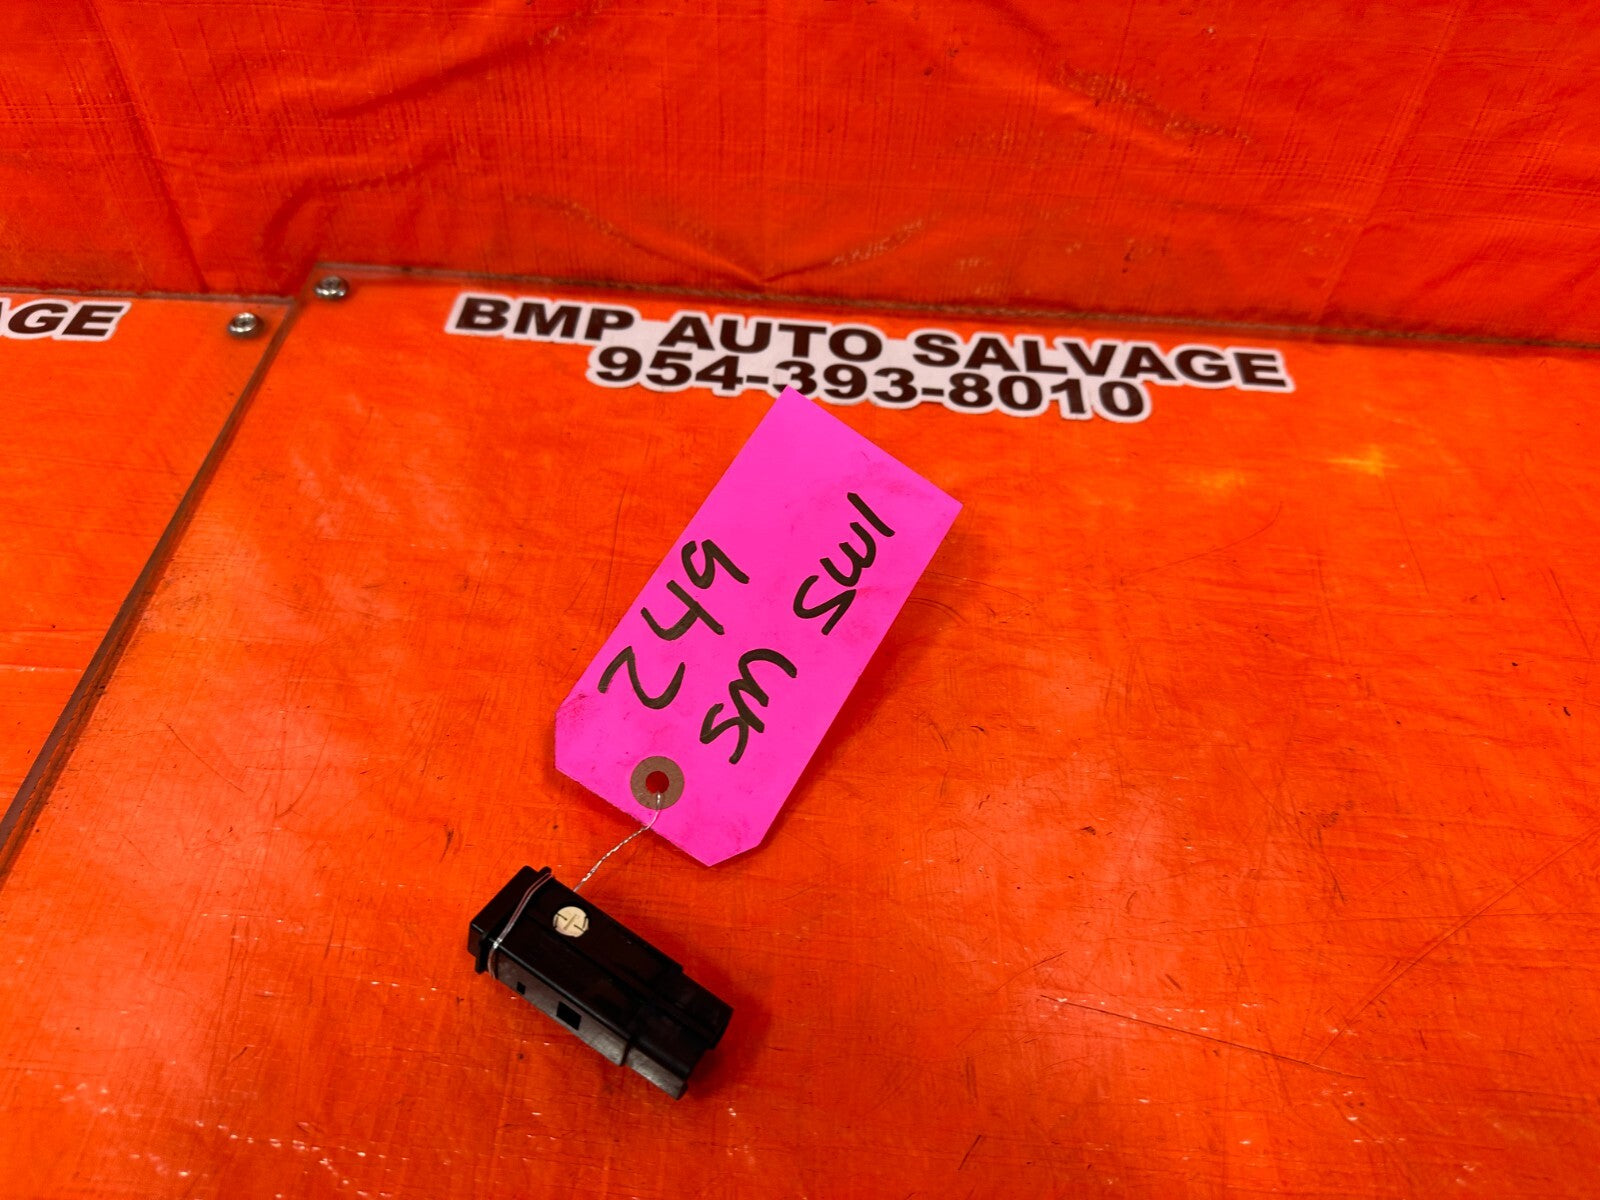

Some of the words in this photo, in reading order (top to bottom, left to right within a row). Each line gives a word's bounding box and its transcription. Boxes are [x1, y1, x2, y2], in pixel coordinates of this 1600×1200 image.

[0, 302, 123, 335] GE
[456, 297, 634, 342] BMP
[659, 316, 883, 362] AUTO
[913, 333, 1286, 388] SALVAGE
[596, 346, 1144, 418] 954-393-8010
[598, 539, 749, 710] 249
